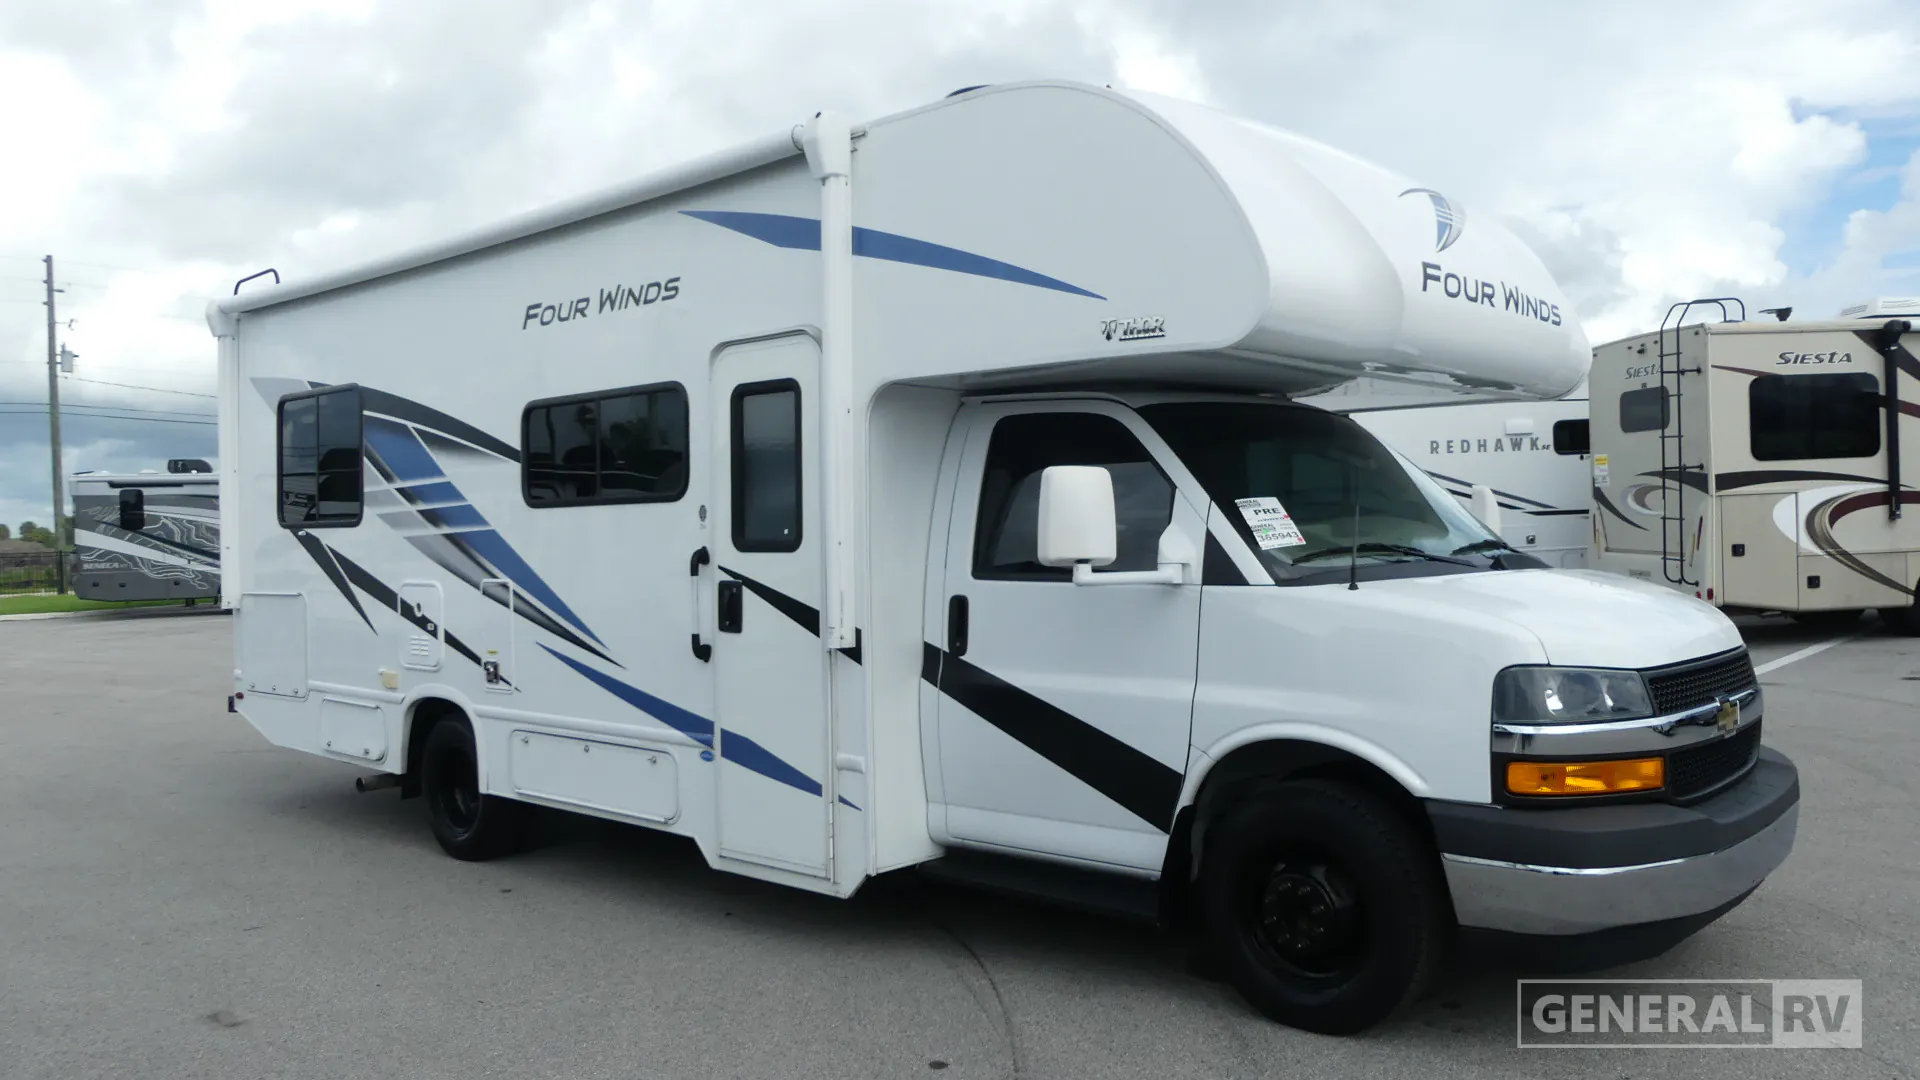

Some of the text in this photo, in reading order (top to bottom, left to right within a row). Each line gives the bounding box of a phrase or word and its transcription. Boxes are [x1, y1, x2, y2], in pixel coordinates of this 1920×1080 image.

[522, 276, 681, 330] FOUR WINDS
[1422, 261, 1561, 326] FOUR WINDS
[1119, 317, 1165, 338] THOR
[1430, 437, 1539, 454] REDHAWK
[1258, 531, 1299, 542] 365943
